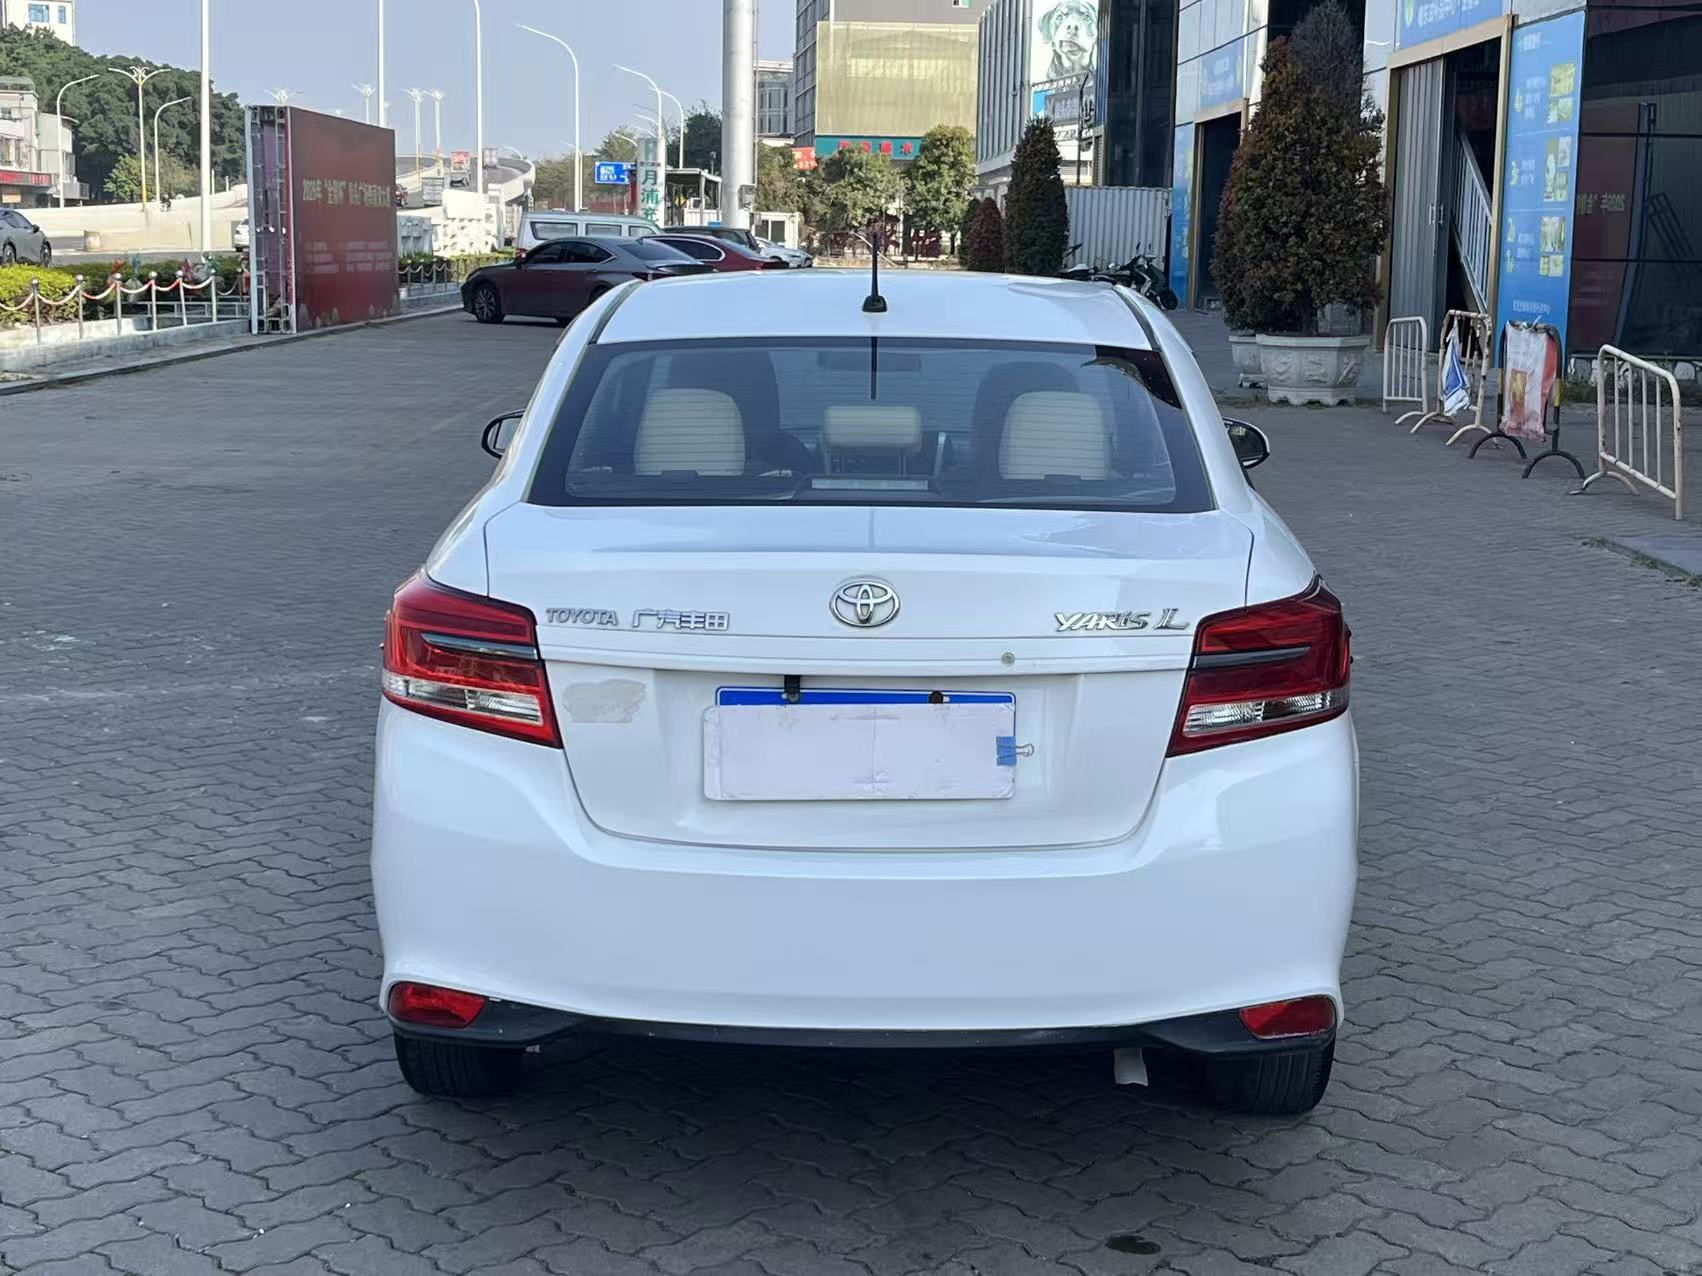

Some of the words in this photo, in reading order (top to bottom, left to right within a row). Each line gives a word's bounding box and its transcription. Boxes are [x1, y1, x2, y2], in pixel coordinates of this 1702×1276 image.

[546, 608, 618, 626] TOYOTA
[632, 608, 730, 631] 广汽丰田
[1054, 611, 1151, 632] YARIS
[1153, 607, 1190, 630] L
